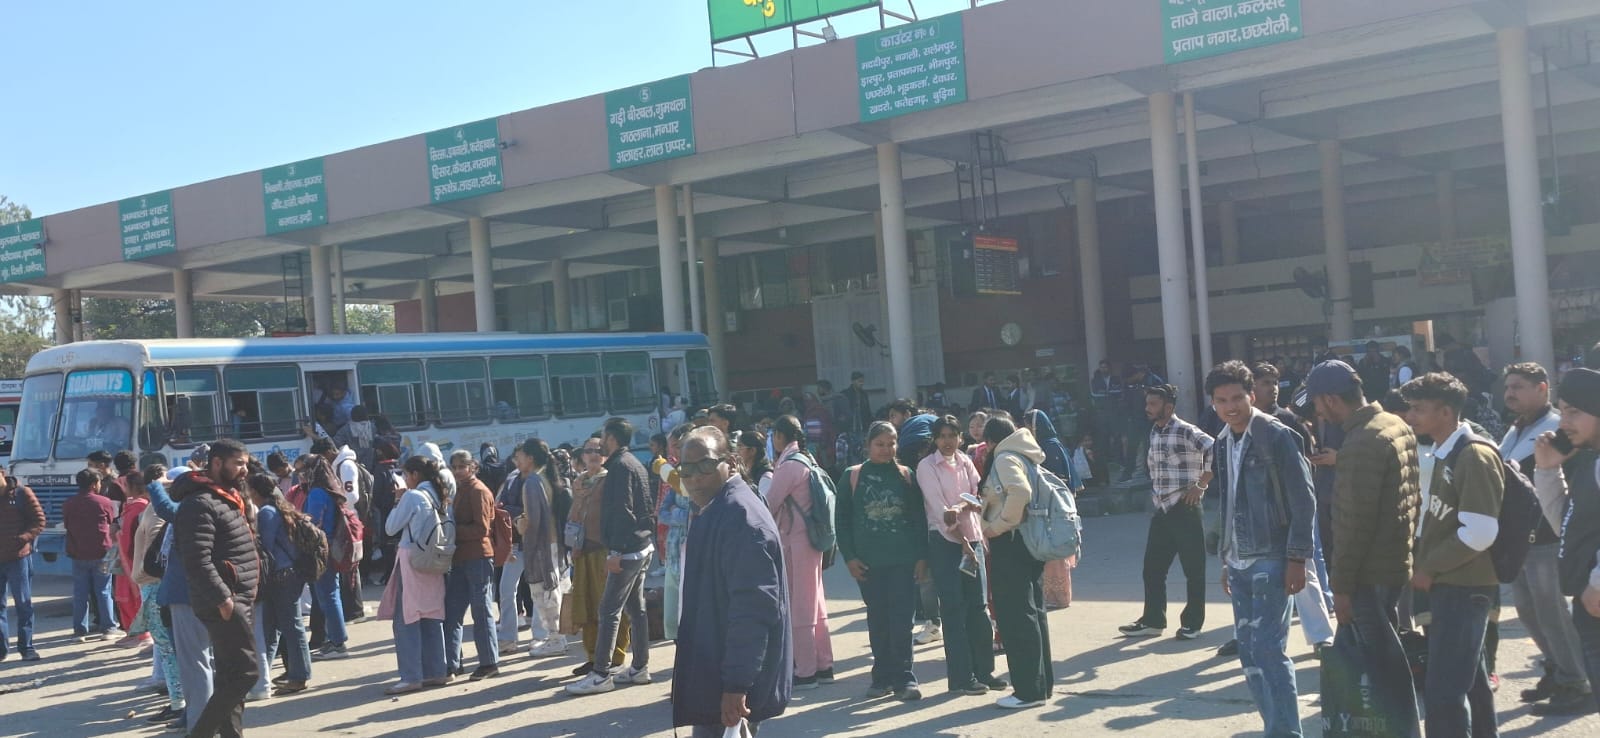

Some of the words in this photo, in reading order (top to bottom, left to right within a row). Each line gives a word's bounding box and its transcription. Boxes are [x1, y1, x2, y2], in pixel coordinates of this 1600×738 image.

[1172, 35, 1205, 56] प्रताप
[642, 88, 649, 100] 5
[68, 372, 124, 392] ROADWAYS
